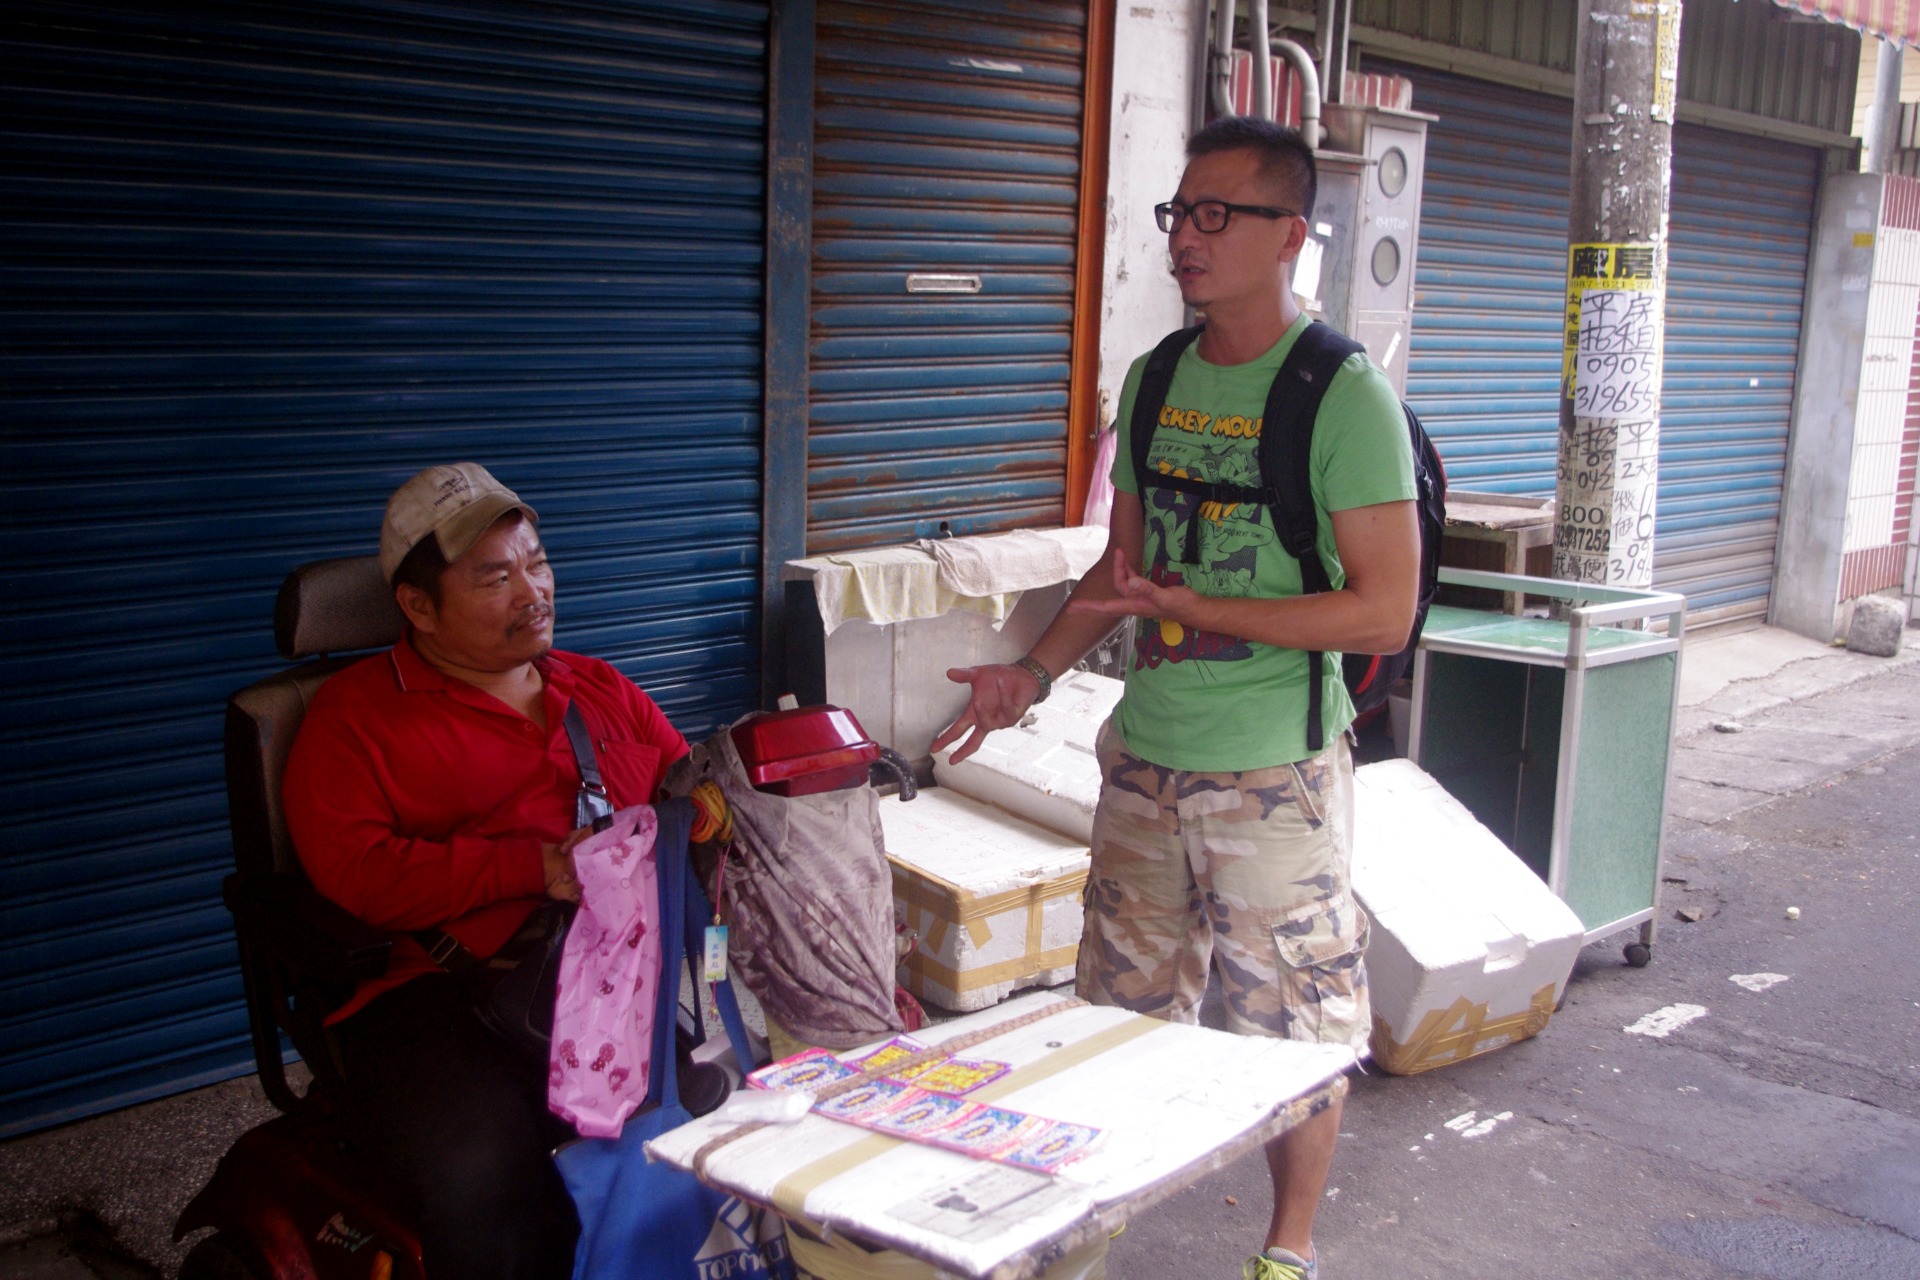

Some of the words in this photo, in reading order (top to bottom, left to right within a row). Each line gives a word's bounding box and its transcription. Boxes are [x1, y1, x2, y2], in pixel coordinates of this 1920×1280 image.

[1580, 320, 1656, 352] 招租
[1586, 351, 1654, 384] 0905
[1576, 381, 1653, 414] 319655
[1211, 413, 1263, 439] MOU
